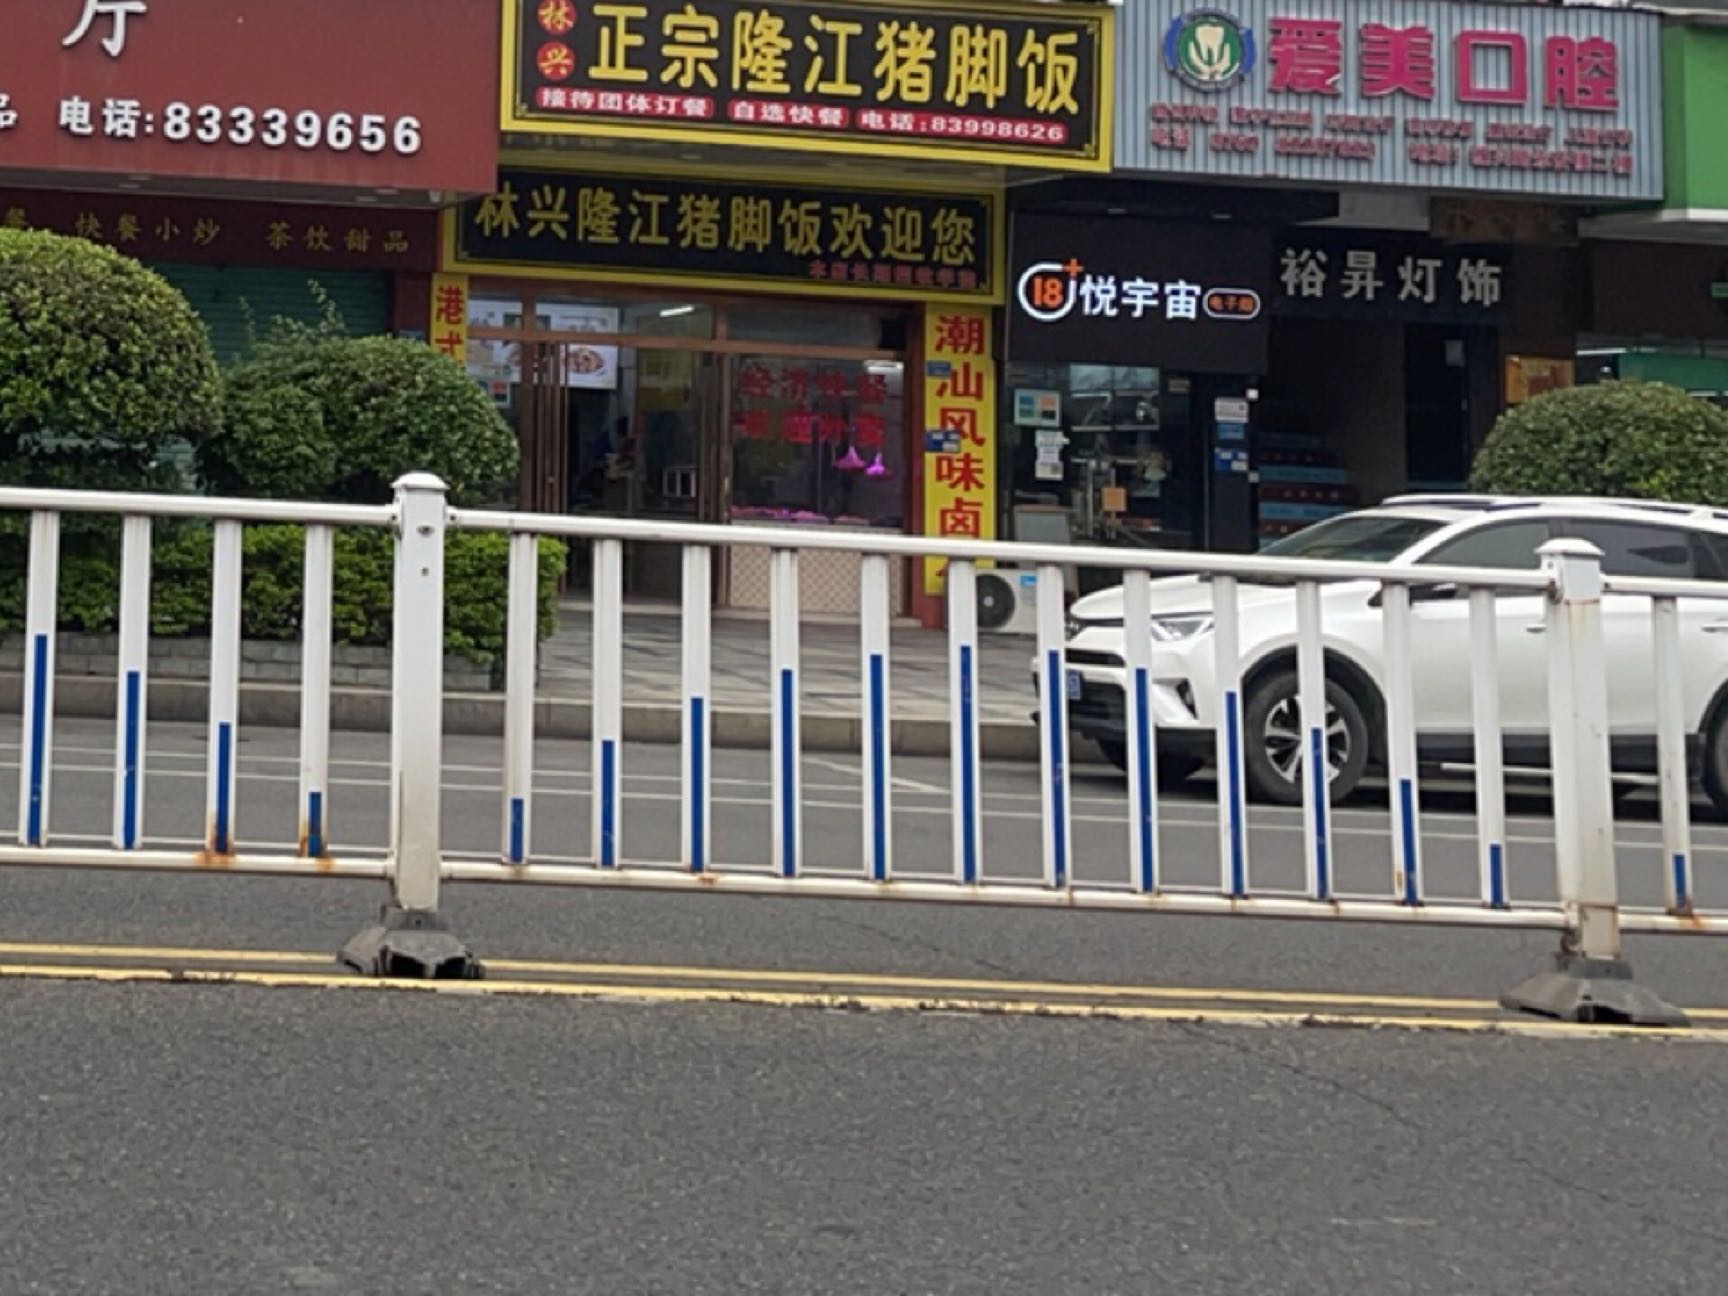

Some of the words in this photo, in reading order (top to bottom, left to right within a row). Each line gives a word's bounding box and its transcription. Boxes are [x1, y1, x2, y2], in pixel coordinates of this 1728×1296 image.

[588, 3, 1079, 115] 正宗隆江猪脚饭
[1268, 16, 1620, 112] 爱美口腔
[540, 87, 707, 117] 接待团体订餐
[732, 100, 843, 126] 自选快餐
[75, 211, 221, 246] 快餐小炒
[265, 221, 409, 254] 茶饮甜品
[475, 182, 977, 265] 林兴隆江猪脚饭欢迎您
[1080, 273, 1201, 320] 悦宇宙
[1279, 247, 1503, 308] 裕昇灯饰
